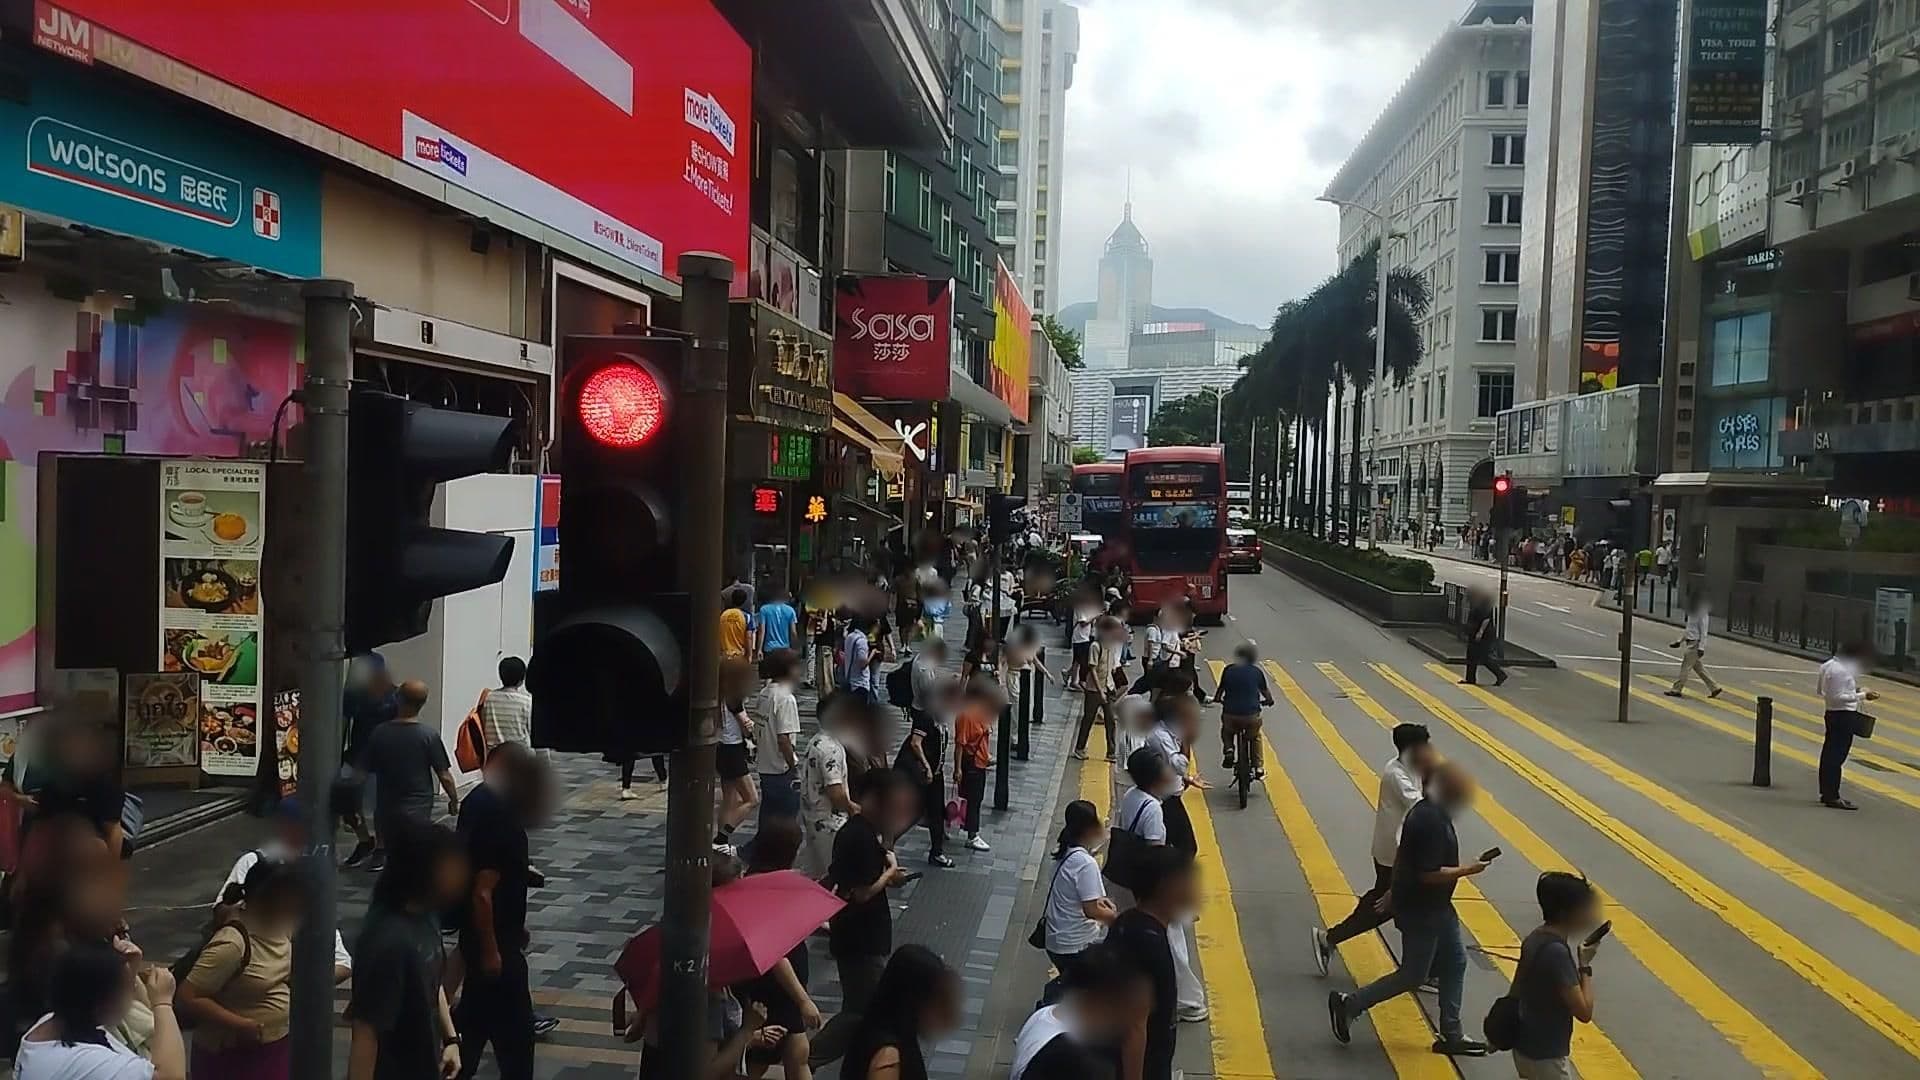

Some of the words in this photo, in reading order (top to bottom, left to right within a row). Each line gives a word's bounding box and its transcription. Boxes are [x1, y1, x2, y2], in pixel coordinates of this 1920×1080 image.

[39, 7, 89, 50] JM
[37, 35, 89, 63] NETWORK
[1700, 38, 1723, 48] VISA
[1728, 38, 1756, 48] TOUR
[1700, 50, 1737, 61] TICKET
[687, 95, 709, 124] more
[709, 102, 732, 147] tickets
[48, 133, 166, 193] watsons
[417, 140, 440, 159] more
[440, 143, 465, 173] tickets
[180, 174, 228, 213] 屈臣氏
[1746, 249, 1775, 265] PARIS
[873, 342, 911, 362] 莎莎
[185, 466, 211, 474] LOCAL
[212, 467, 260, 475] SPECIALTIES
